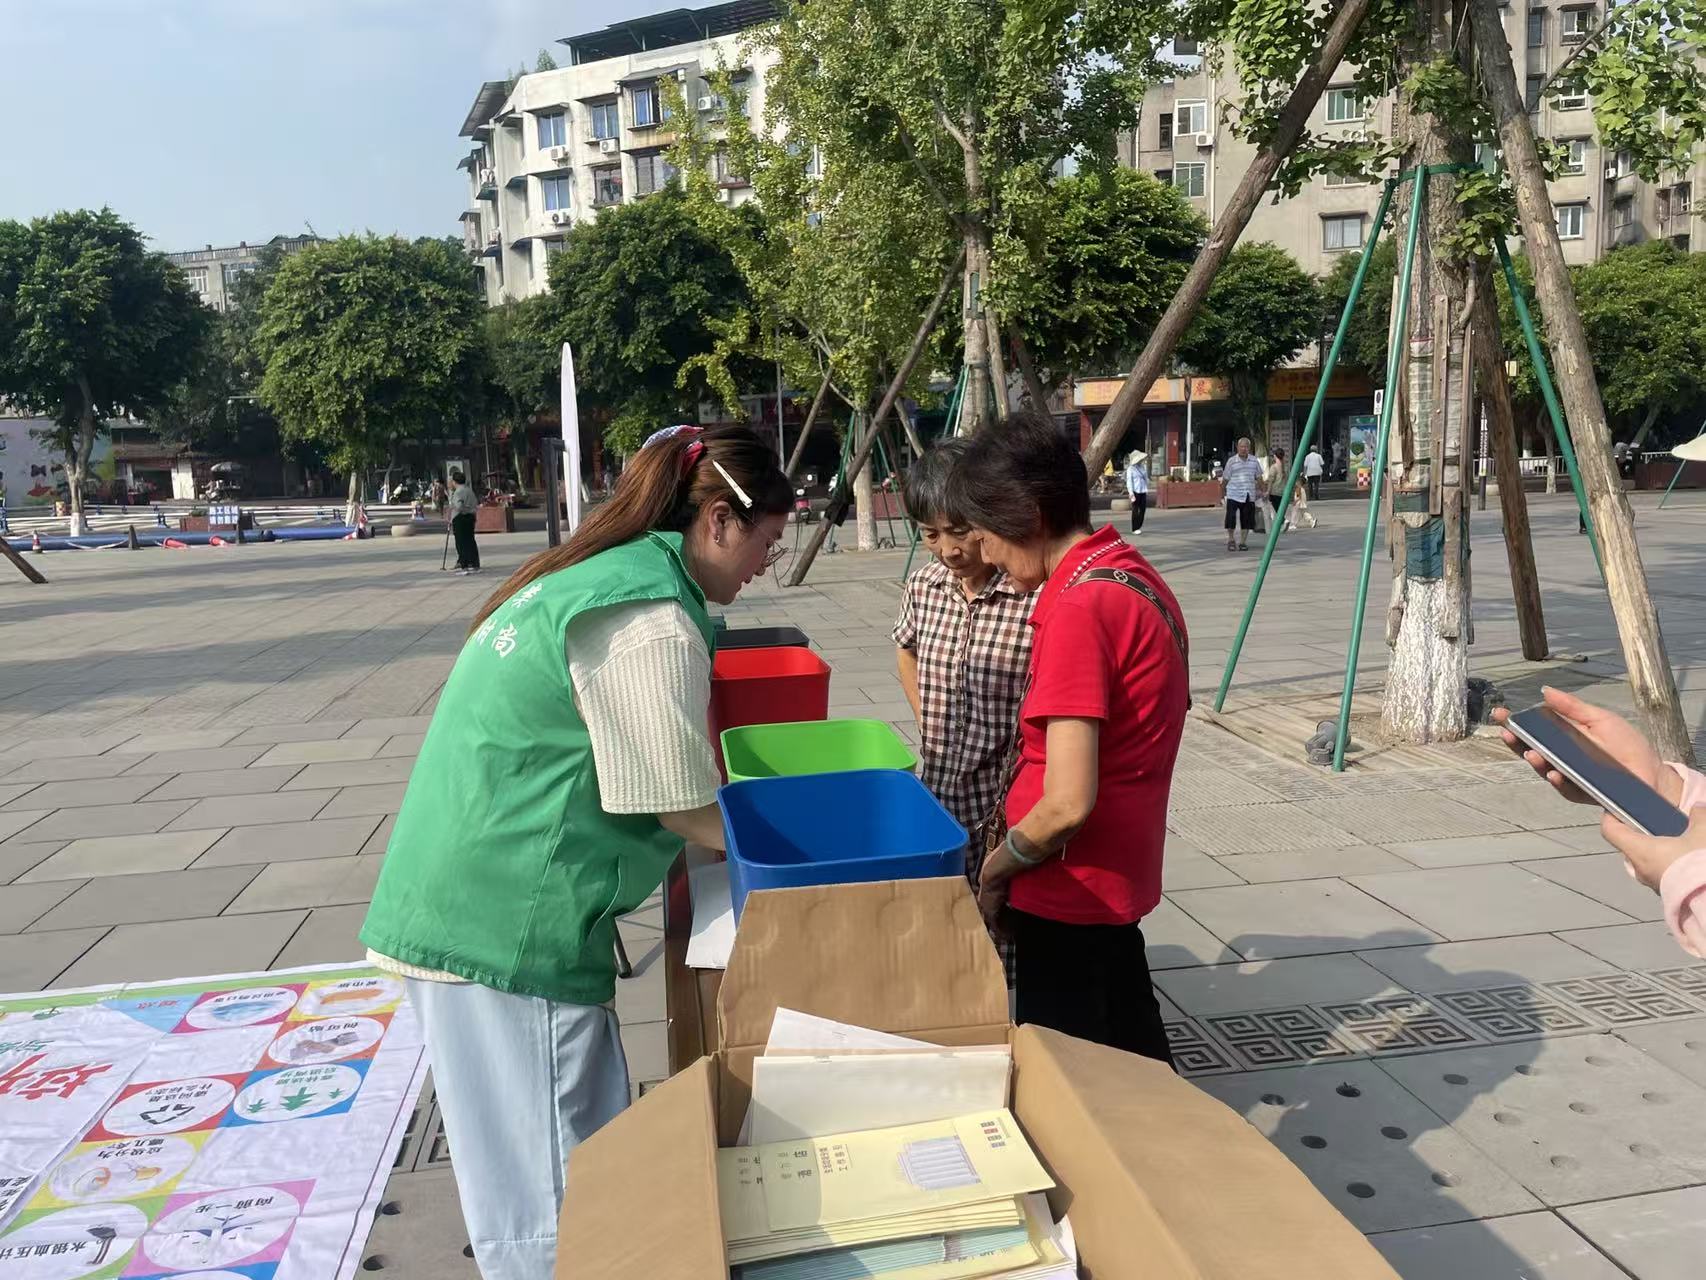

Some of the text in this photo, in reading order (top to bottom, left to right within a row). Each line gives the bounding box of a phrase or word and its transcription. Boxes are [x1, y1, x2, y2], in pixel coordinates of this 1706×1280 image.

[98, 1146, 164, 1160] 垃圾分为
[195, 1196, 274, 1214] 向前一步
